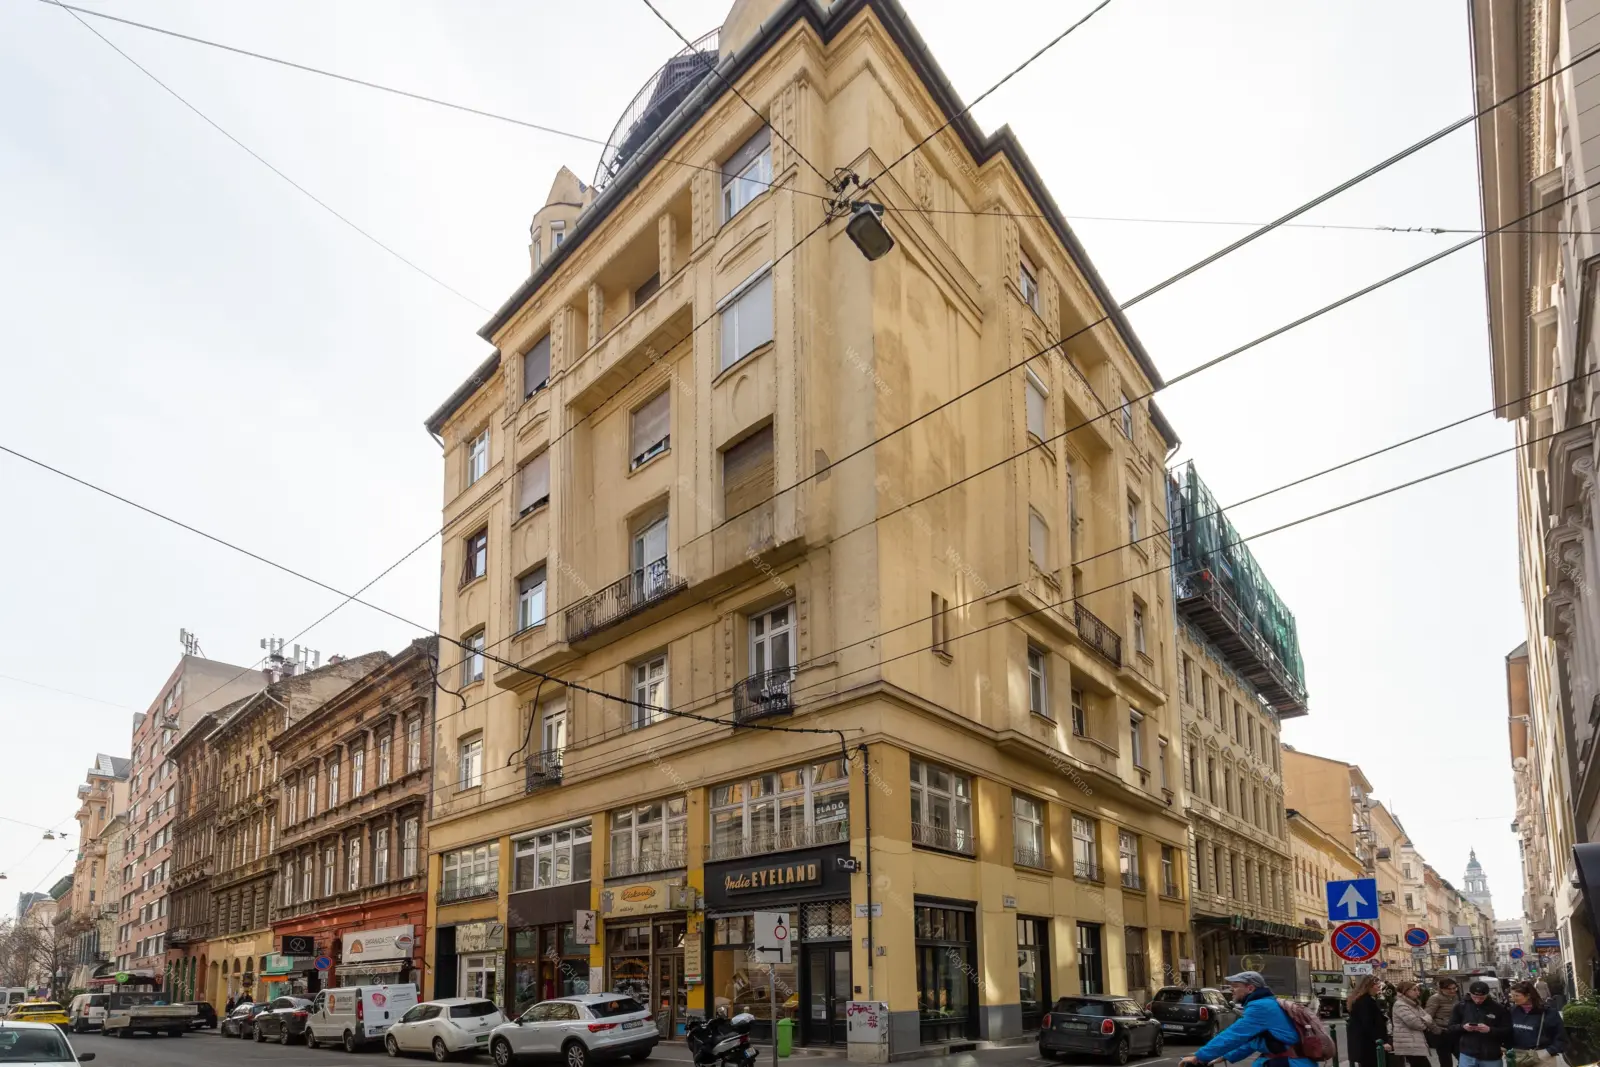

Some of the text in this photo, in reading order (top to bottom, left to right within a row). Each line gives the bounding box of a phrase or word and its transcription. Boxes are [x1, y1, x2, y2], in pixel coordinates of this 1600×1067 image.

[816, 800, 844, 814] ELADÓ
[724, 863, 817, 890] Indie EYELAND
